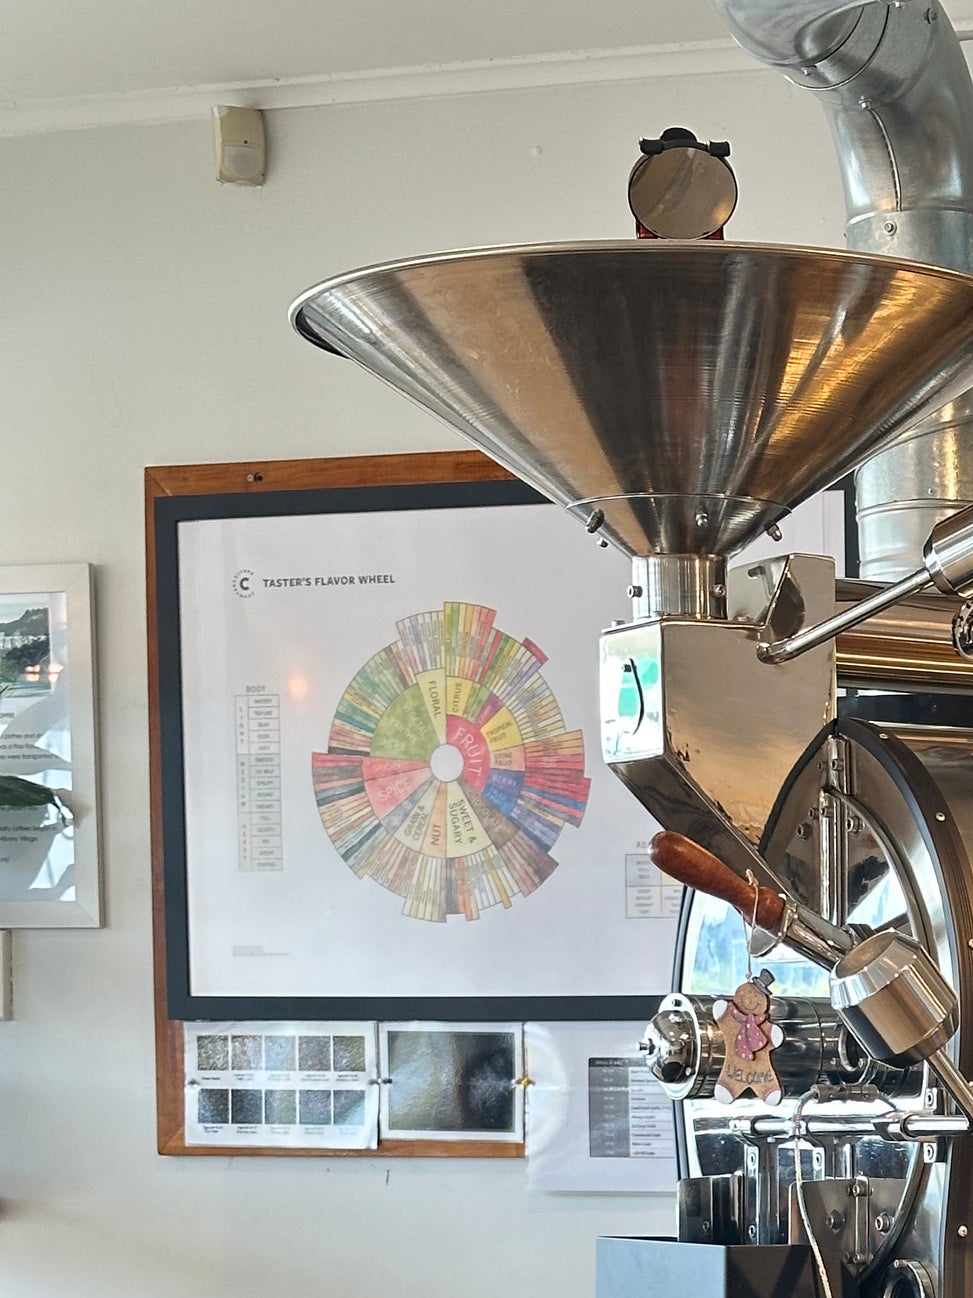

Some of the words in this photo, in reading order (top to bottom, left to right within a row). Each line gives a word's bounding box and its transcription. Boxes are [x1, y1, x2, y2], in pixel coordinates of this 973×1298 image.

[263, 577, 311, 588] TASTER'S
[315, 576, 355, 587] FLAVOR
[358, 574, 395, 585] WHEEL
[428, 680, 442, 718] FLORAL
[452, 683, 462, 712] CITRUS
[454, 727, 482, 776] FRUIT
[379, 777, 412, 801] SPICE
[449, 802, 463, 844] SUGARY
[459, 799, 474, 832] SWEET
[431, 824, 442, 846] NUT
